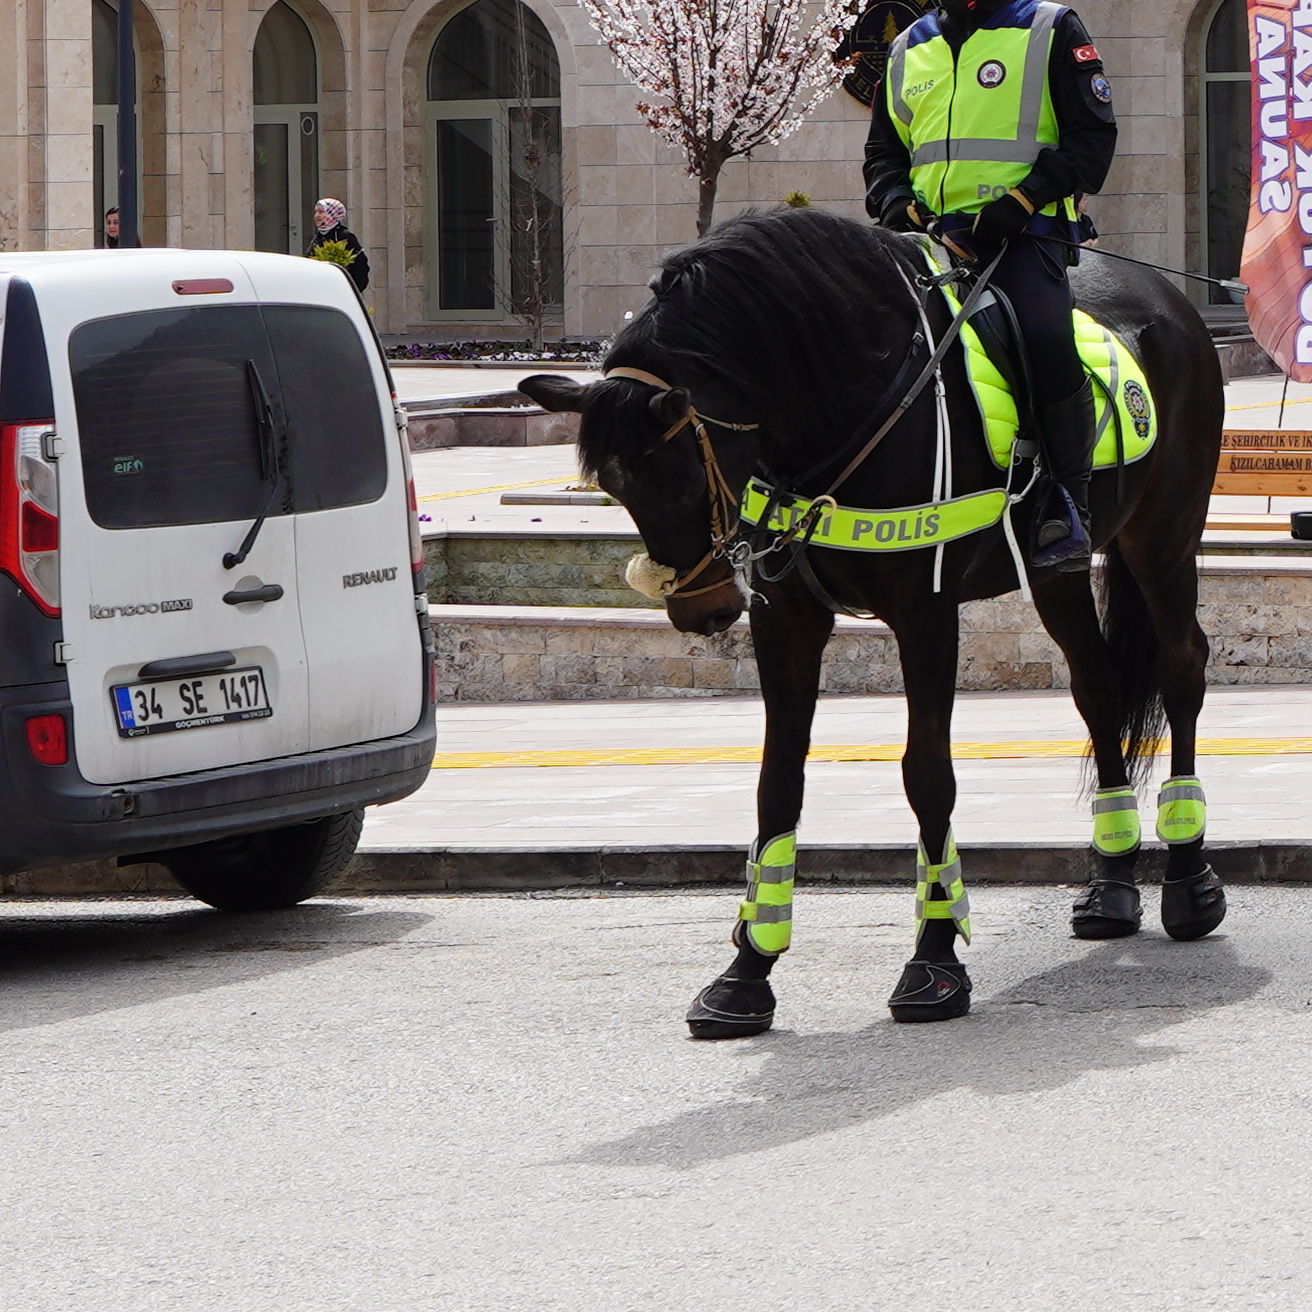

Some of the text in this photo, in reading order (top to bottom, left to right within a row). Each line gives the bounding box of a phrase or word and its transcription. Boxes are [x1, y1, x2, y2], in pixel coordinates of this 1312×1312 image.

[1288, 435, 1300, 447] VE
[114, 461, 133, 474] elf
[852, 511, 941, 542] POLİS
[343, 567, 398, 589] RENAULT
[90, 598, 193, 620] Kangoo MAXI
[135, 675, 259, 721] 34 SE 1417
[122, 710, 134, 721] TR
